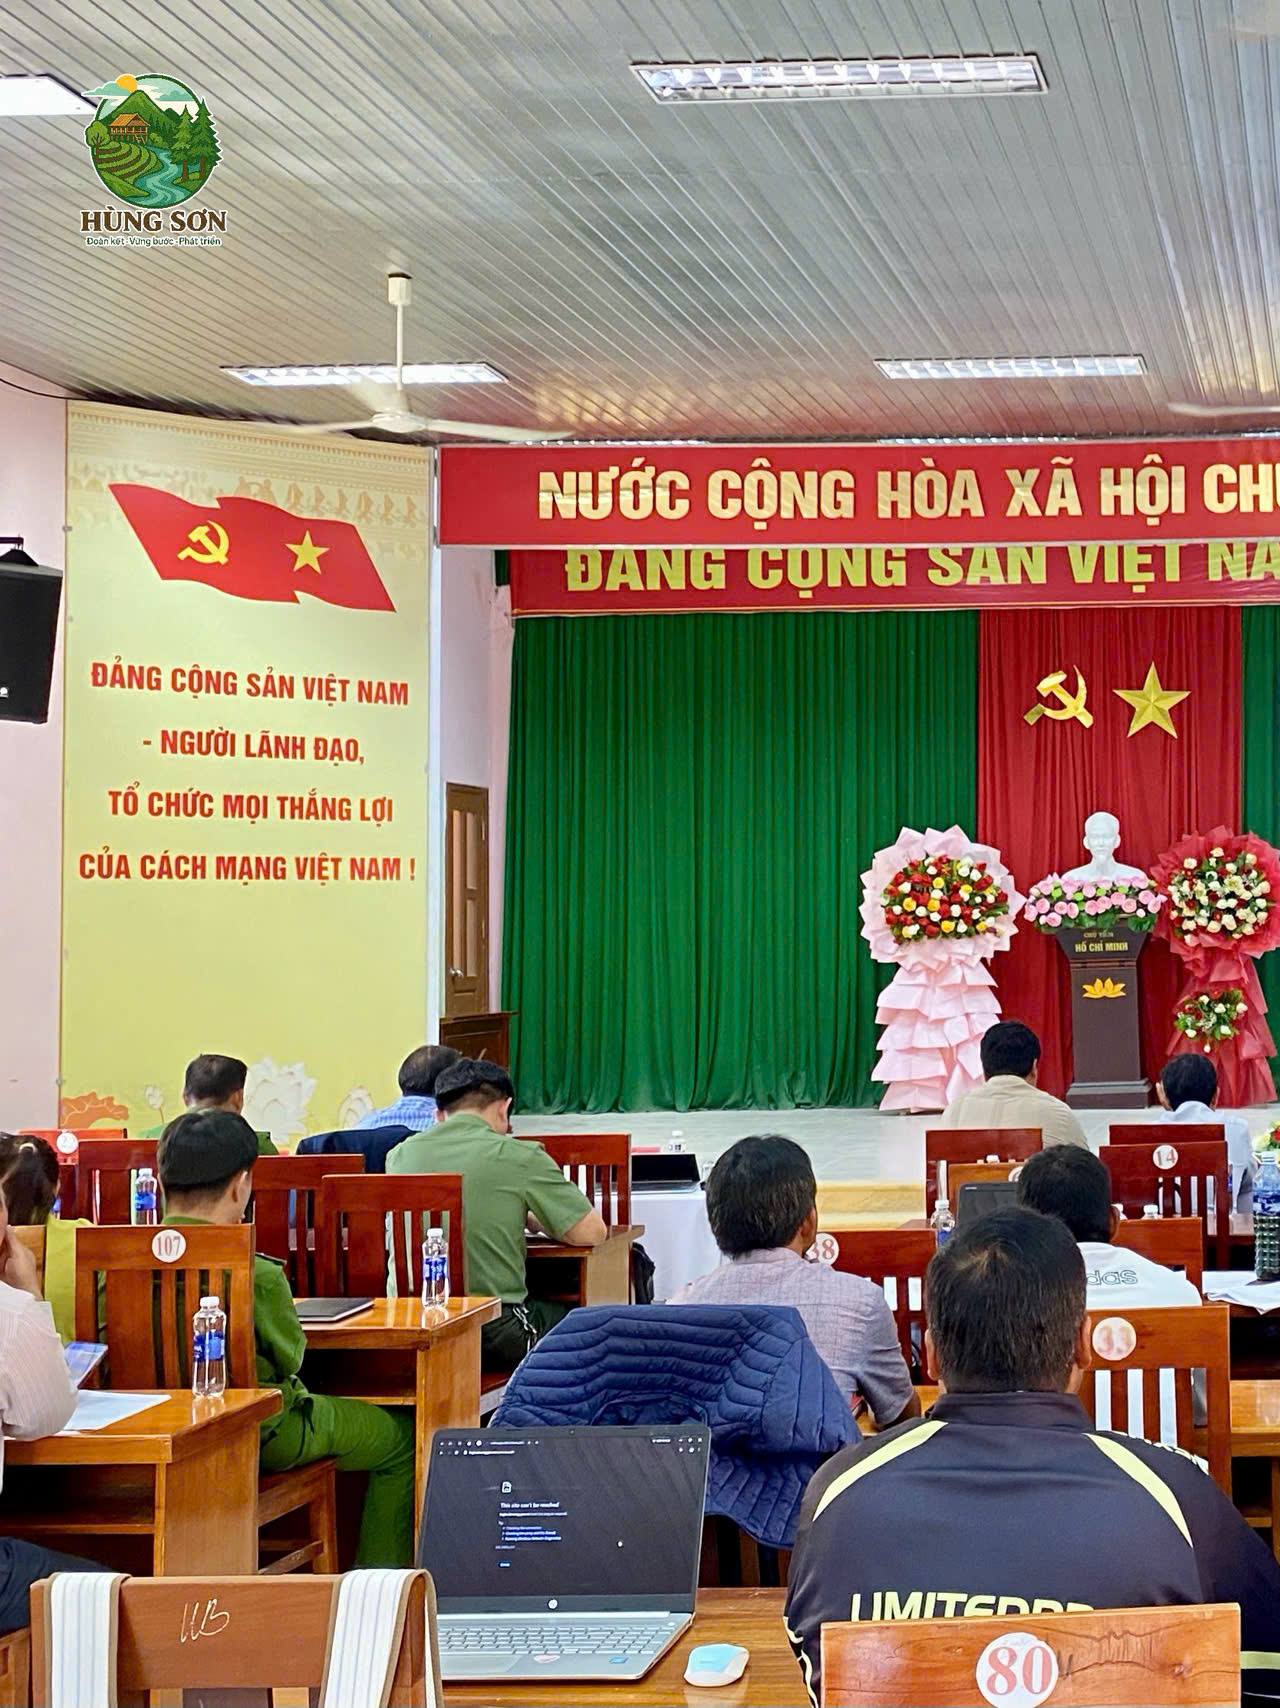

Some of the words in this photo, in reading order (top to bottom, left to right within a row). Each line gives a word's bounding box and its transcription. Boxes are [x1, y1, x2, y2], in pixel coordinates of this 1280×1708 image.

[538, 456, 690, 520] NƯỚC
[708, 457, 855, 530] CỘNG
[877, 457, 985, 519] HÒA
[1005, 456, 1082, 517] XÃ
[1100, 454, 1186, 526] HỘI
[91, 655, 162, 691] ĐẢNG
[171, 664, 238, 699] CỘNG
[246, 666, 295, 699] SẢN
[303, 673, 350, 707] VIỆT
[358, 680, 409, 706] NAM
[161, 726, 236, 758] NGƯỜI
[244, 730, 306, 761] LÃNH
[313, 737, 365, 767] ĐẠO,
[108, 780, 141, 817] TỔ
[148, 787, 214, 818] CHỨC
[222, 794, 268, 825] MỌI
[276, 788, 352, 822] THẮNG
[359, 796, 393, 828] LỢI
[79, 845, 132, 880] CỦA
[139, 849, 207, 880] CÁCH
[215, 856, 287, 886] MẠNG
[295, 852, 342, 886] VIỆT
[349, 857, 401, 881] NAM
[410, 858, 416, 881] !
[1156, 1149, 1176, 1166] 14
[157, 1235, 181, 1257] 107
[1086, 1269, 1138, 1286] das
[986, 1645, 1053, 1695] 80
